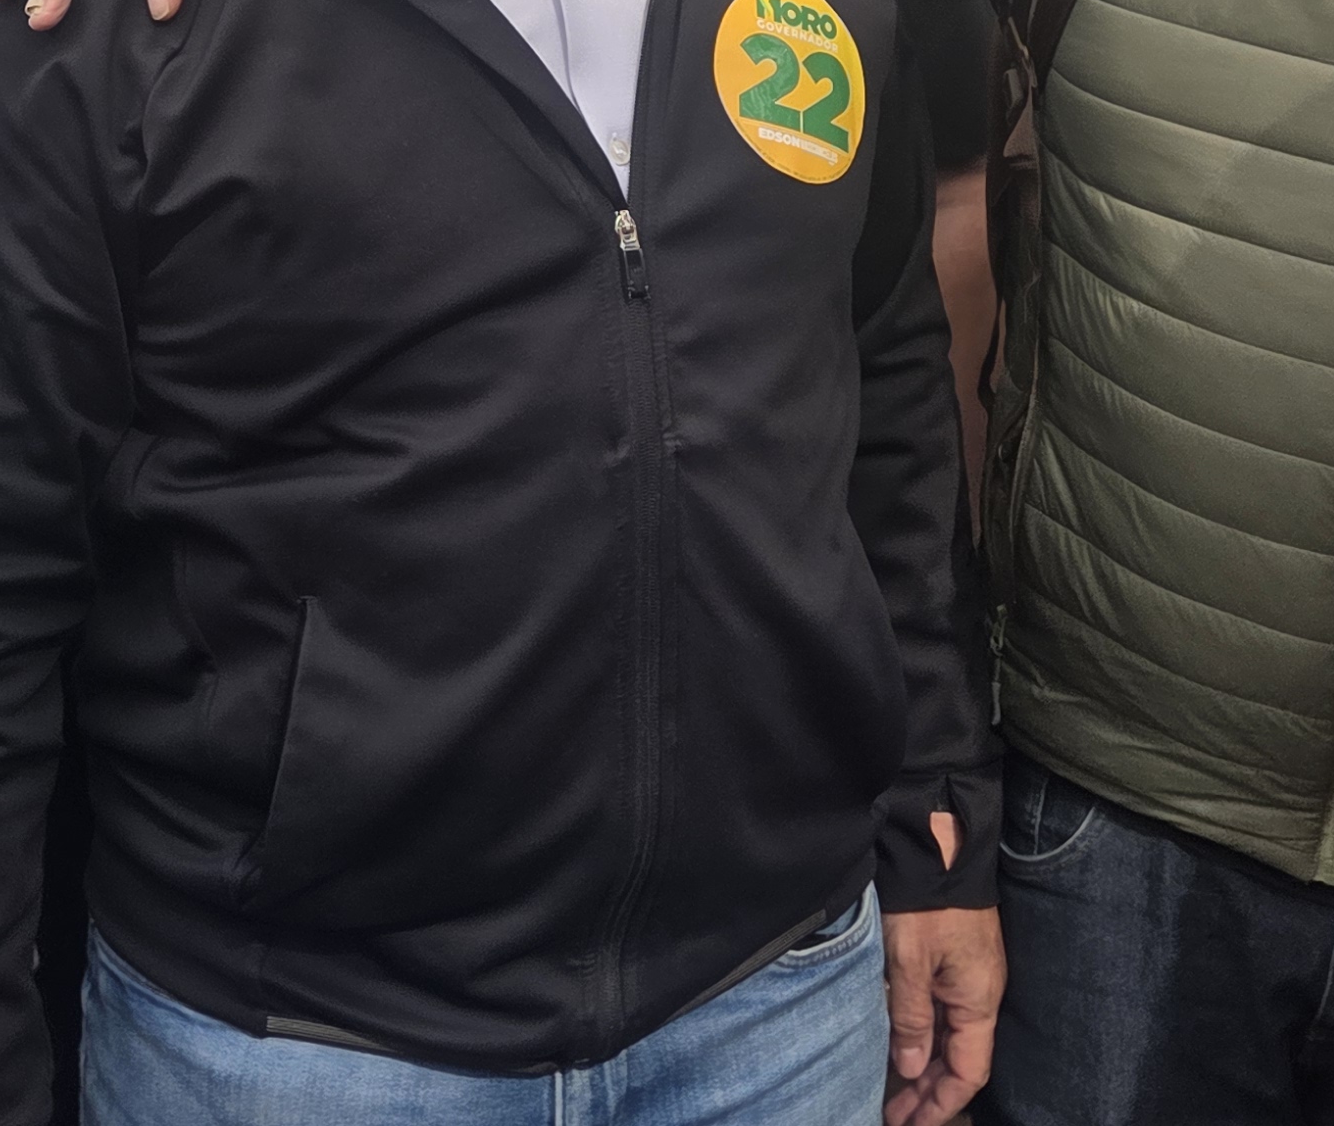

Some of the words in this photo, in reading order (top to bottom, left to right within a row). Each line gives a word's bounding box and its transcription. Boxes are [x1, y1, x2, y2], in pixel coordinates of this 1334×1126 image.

[756, 17, 838, 53] GOVERNADOR
[739, 32, 850, 153] 22
[758, 126, 800, 148] EDSON
